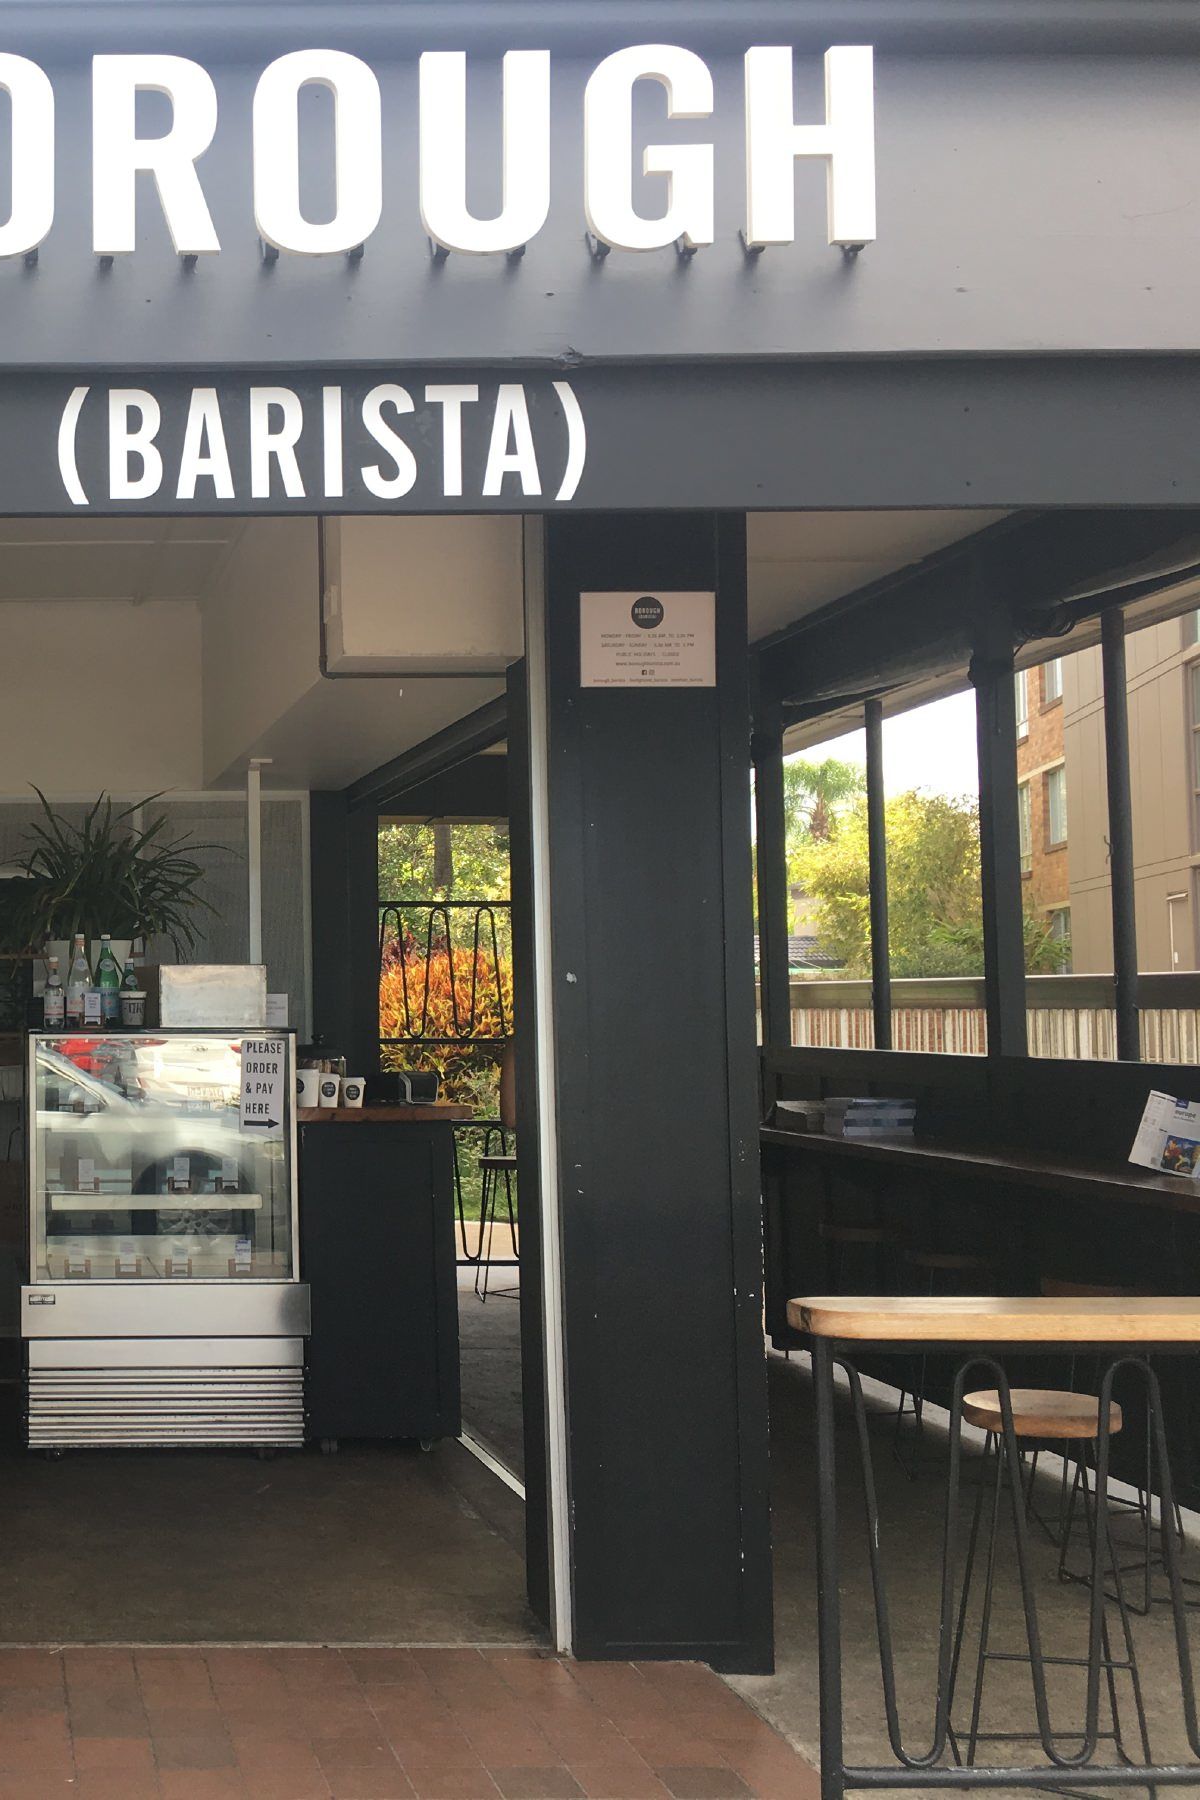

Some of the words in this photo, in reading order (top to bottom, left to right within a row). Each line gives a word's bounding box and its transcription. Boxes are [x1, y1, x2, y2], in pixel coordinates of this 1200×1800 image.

[57, 381, 588, 506] (BARISTA)
[246, 1042, 282, 1054] PLEASE
[246, 1062, 278, 1075] ORDER
[245, 1082, 252, 1094] &
[256, 1082, 274, 1095] PAY
[245, 1103, 270, 1115] HERE
